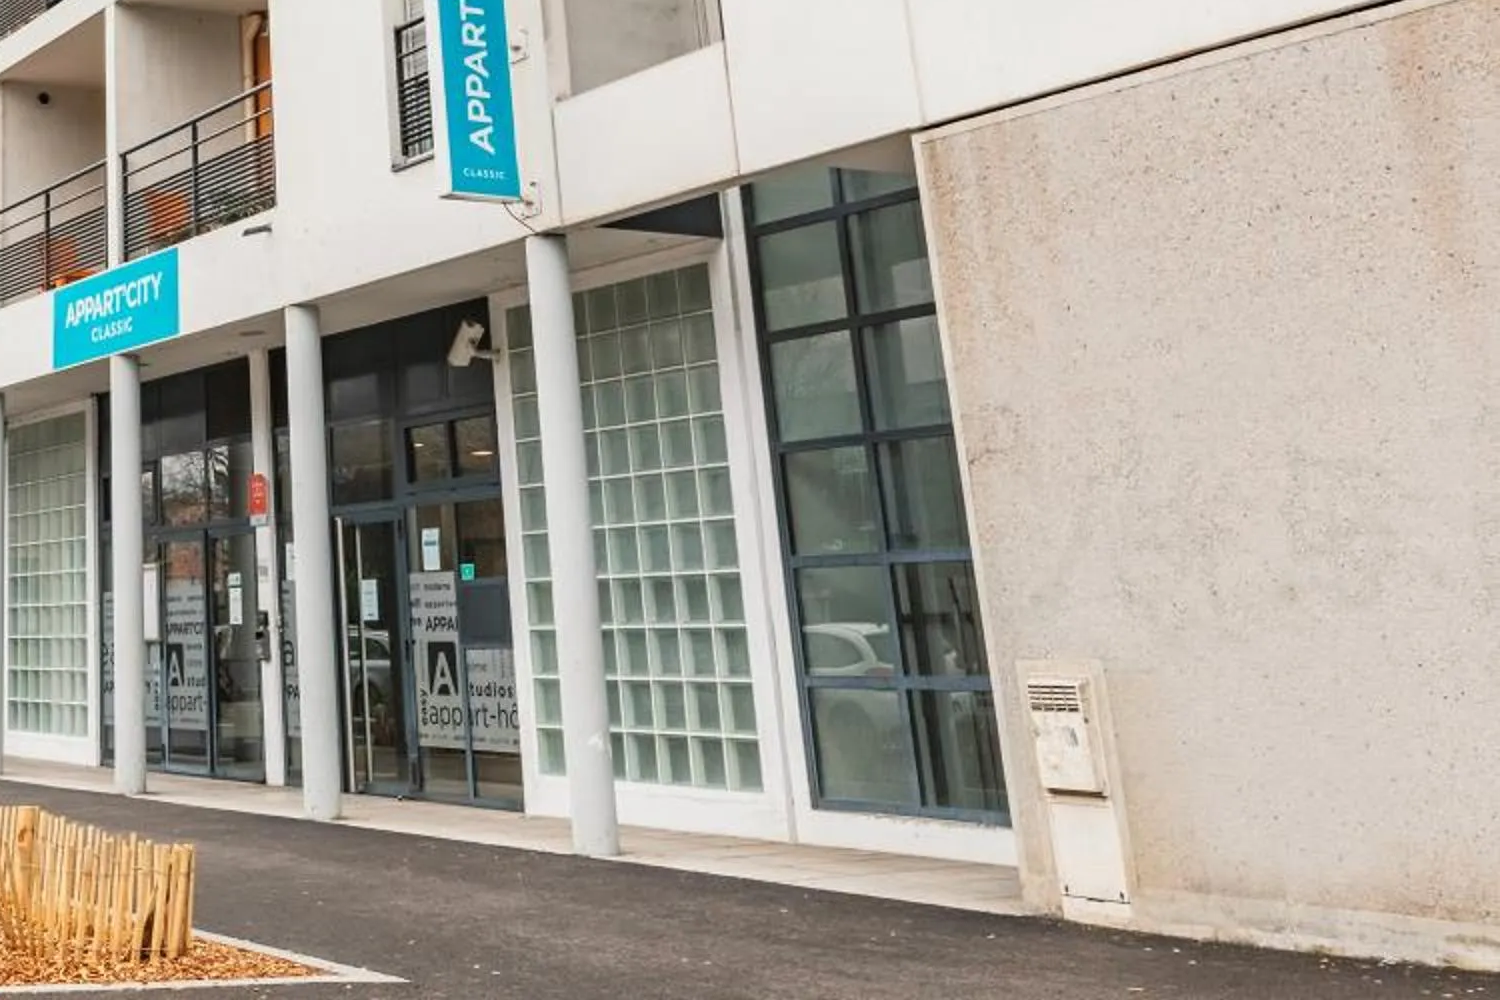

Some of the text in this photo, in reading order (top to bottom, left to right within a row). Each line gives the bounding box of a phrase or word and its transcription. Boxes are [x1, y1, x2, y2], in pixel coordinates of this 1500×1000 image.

[463, 167, 505, 180] CLASSIC
[65, 271, 163, 329] APPART'CITY
[91, 316, 133, 343] CLASSIC
[468, 682, 514, 698] tudios
